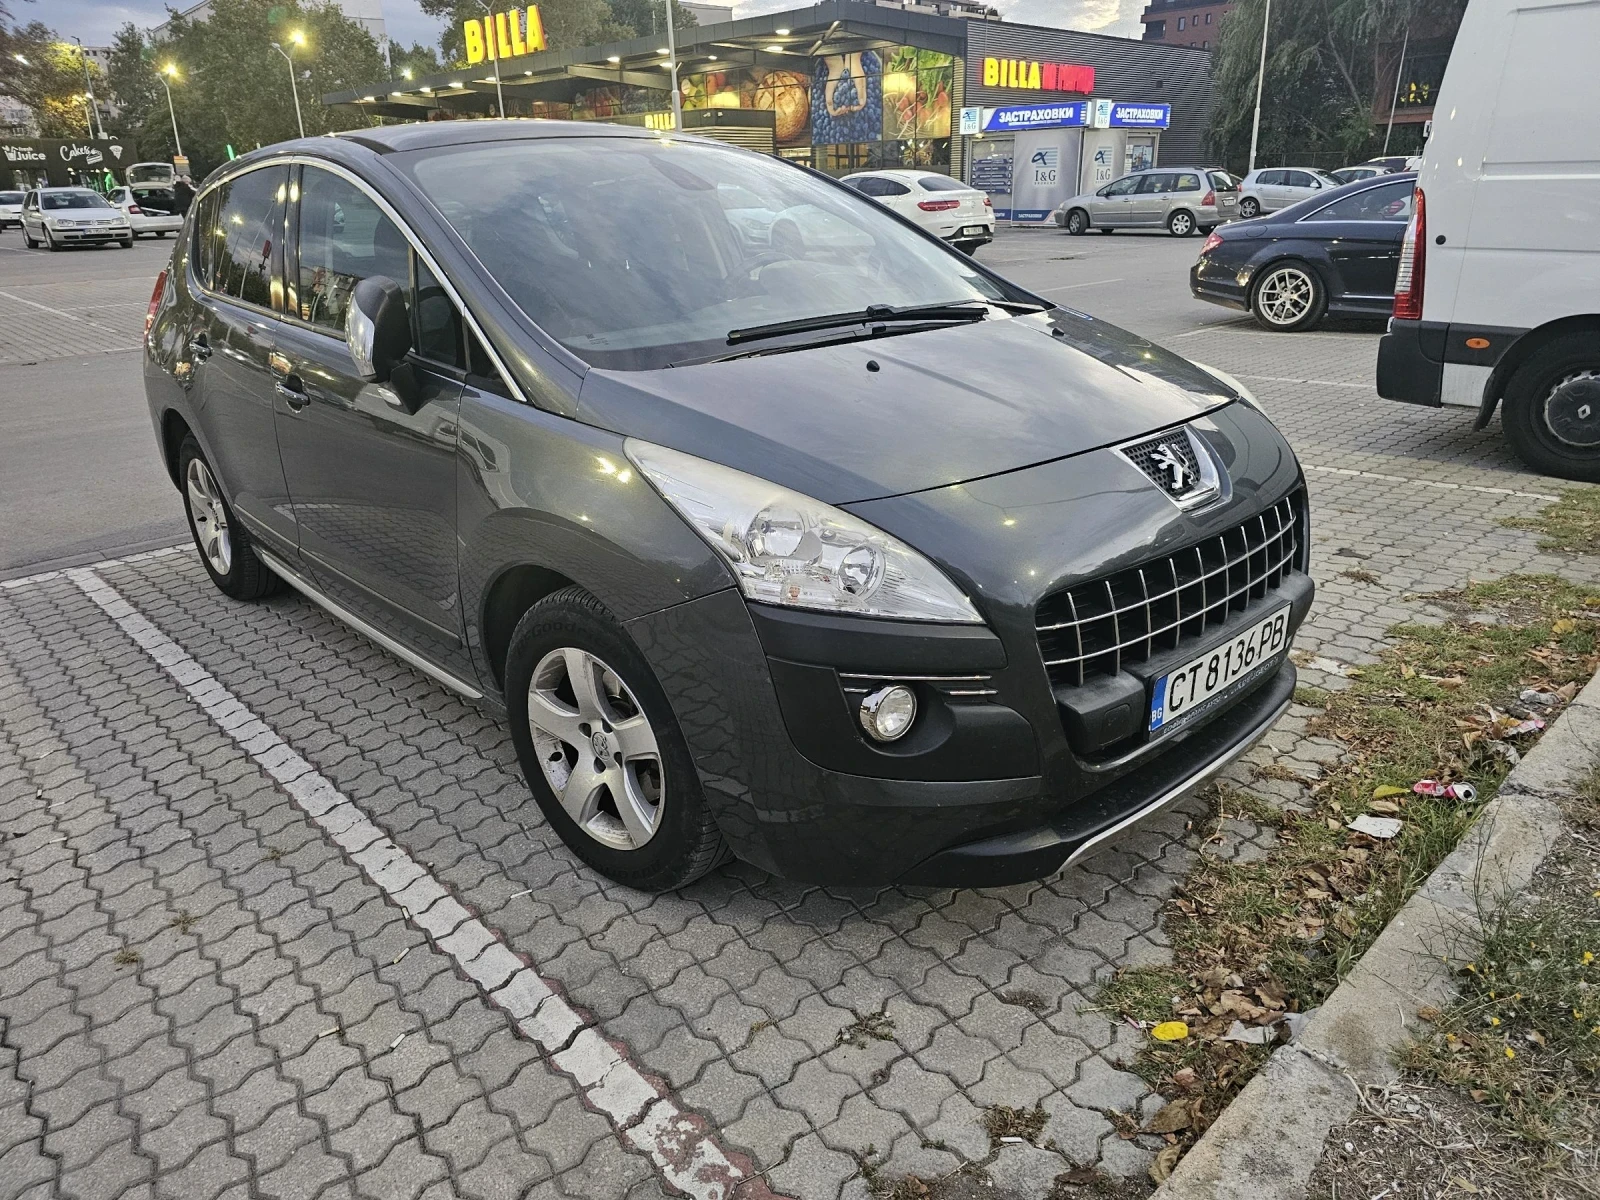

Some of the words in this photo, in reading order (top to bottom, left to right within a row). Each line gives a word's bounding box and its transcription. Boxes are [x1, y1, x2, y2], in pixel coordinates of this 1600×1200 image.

[463, 5, 546, 63] BILLA
[983, 57, 1041, 90] BILLA
[998, 106, 1074, 123] ЗАСТРАХОВКИ
[1115, 106, 1164, 120] ЗАСТРАХОВКИ
[17, 151, 47, 161] Juice
[60, 143, 90, 161] Cakes
[1035, 169, 1057, 182] I&G
[1096, 168, 1111, 181] I&G
[1169, 662, 1203, 711] CT
[1206, 631, 1255, 691] 8136
[1259, 614, 1284, 659] PB
[1151, 707, 1163, 723] BG
